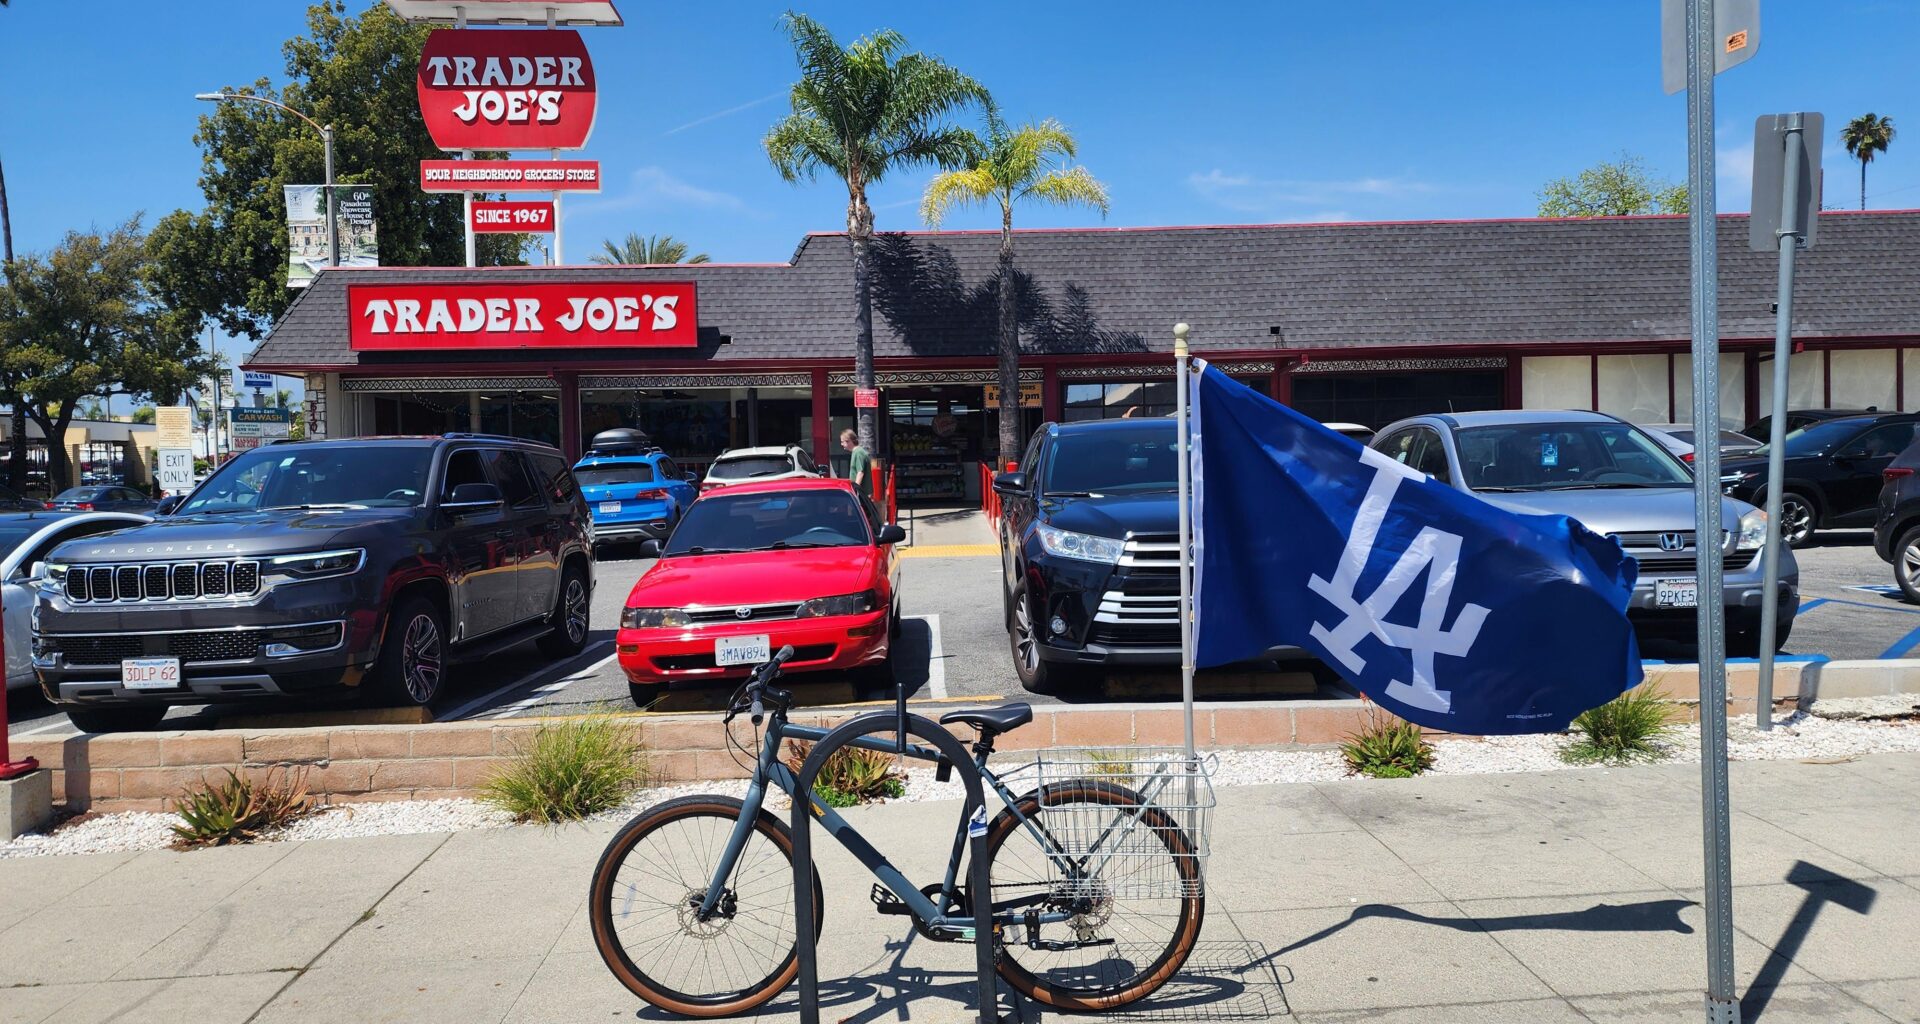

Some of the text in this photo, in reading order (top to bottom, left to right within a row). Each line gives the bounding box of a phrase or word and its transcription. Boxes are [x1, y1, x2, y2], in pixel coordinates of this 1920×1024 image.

[426, 56, 585, 86] TRADER
[452, 89, 563, 123] JOE'S
[425, 169, 596, 181] YOUR NEIGHBORHOOD GROCERY STORE
[343, 211, 372, 220] House of
[475, 209, 548, 224] SINCE 1967
[364, 293, 679, 333] TRADER JOE'S
[245, 372, 271, 380] WASH
[988, 392, 994, 401] 8
[1025, 393, 1040, 401] pm
[166, 455, 185, 467] EXIT
[164, 470, 189, 483] ONLY
[91, 544, 234, 555] WAGONEER
[1307, 446, 1492, 713] LA
[1660, 590, 1698, 603] 9PKF5
[720, 646, 766, 662] 3MAV894
[125, 666, 177, 682] 3DLP 62
